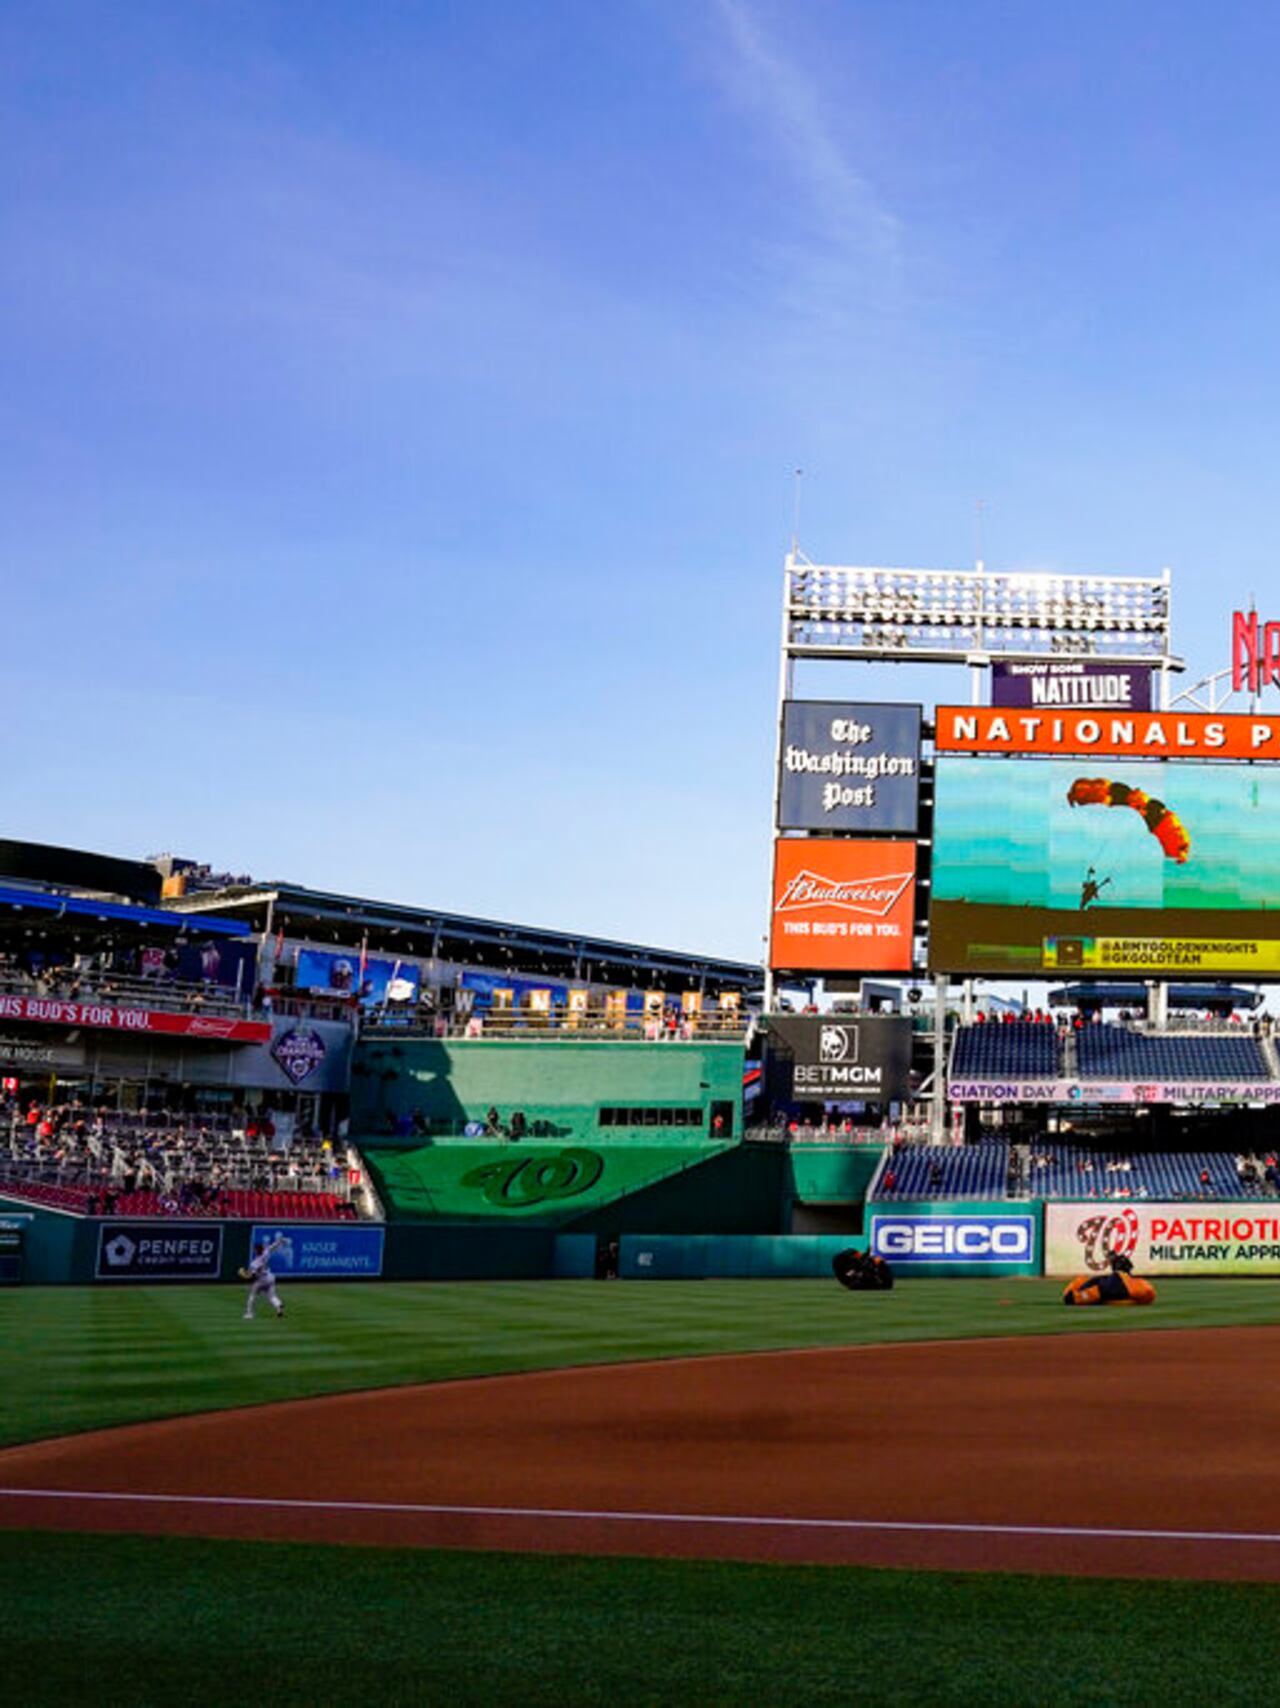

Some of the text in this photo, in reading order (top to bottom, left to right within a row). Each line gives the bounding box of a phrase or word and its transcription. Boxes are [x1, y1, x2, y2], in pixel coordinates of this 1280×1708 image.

[1032, 675, 1132, 704] NATITUDE
[830, 719, 872, 744] The
[953, 716, 1225, 748] NATIONALS
[785, 746, 915, 777] Washington
[823, 783, 875, 810] Post
[787, 880, 898, 901] Budweiser
[784, 922, 810, 935] THIS
[812, 922, 848, 936] BUD'S
[850, 923, 874, 936] FOR
[27, 1000, 78, 1021] BUD'S
[81, 1006, 114, 1024] FOR
[794, 1065, 882, 1082] BETMGM
[950, 1084, 1056, 1099] CIATION DAY
[1163, 1087, 1236, 1100] MILITARY
[139, 1239, 214, 1255] PENFED
[877, 1224, 1029, 1254] GEICO
[1150, 1244, 1229, 1260] MILITARY
